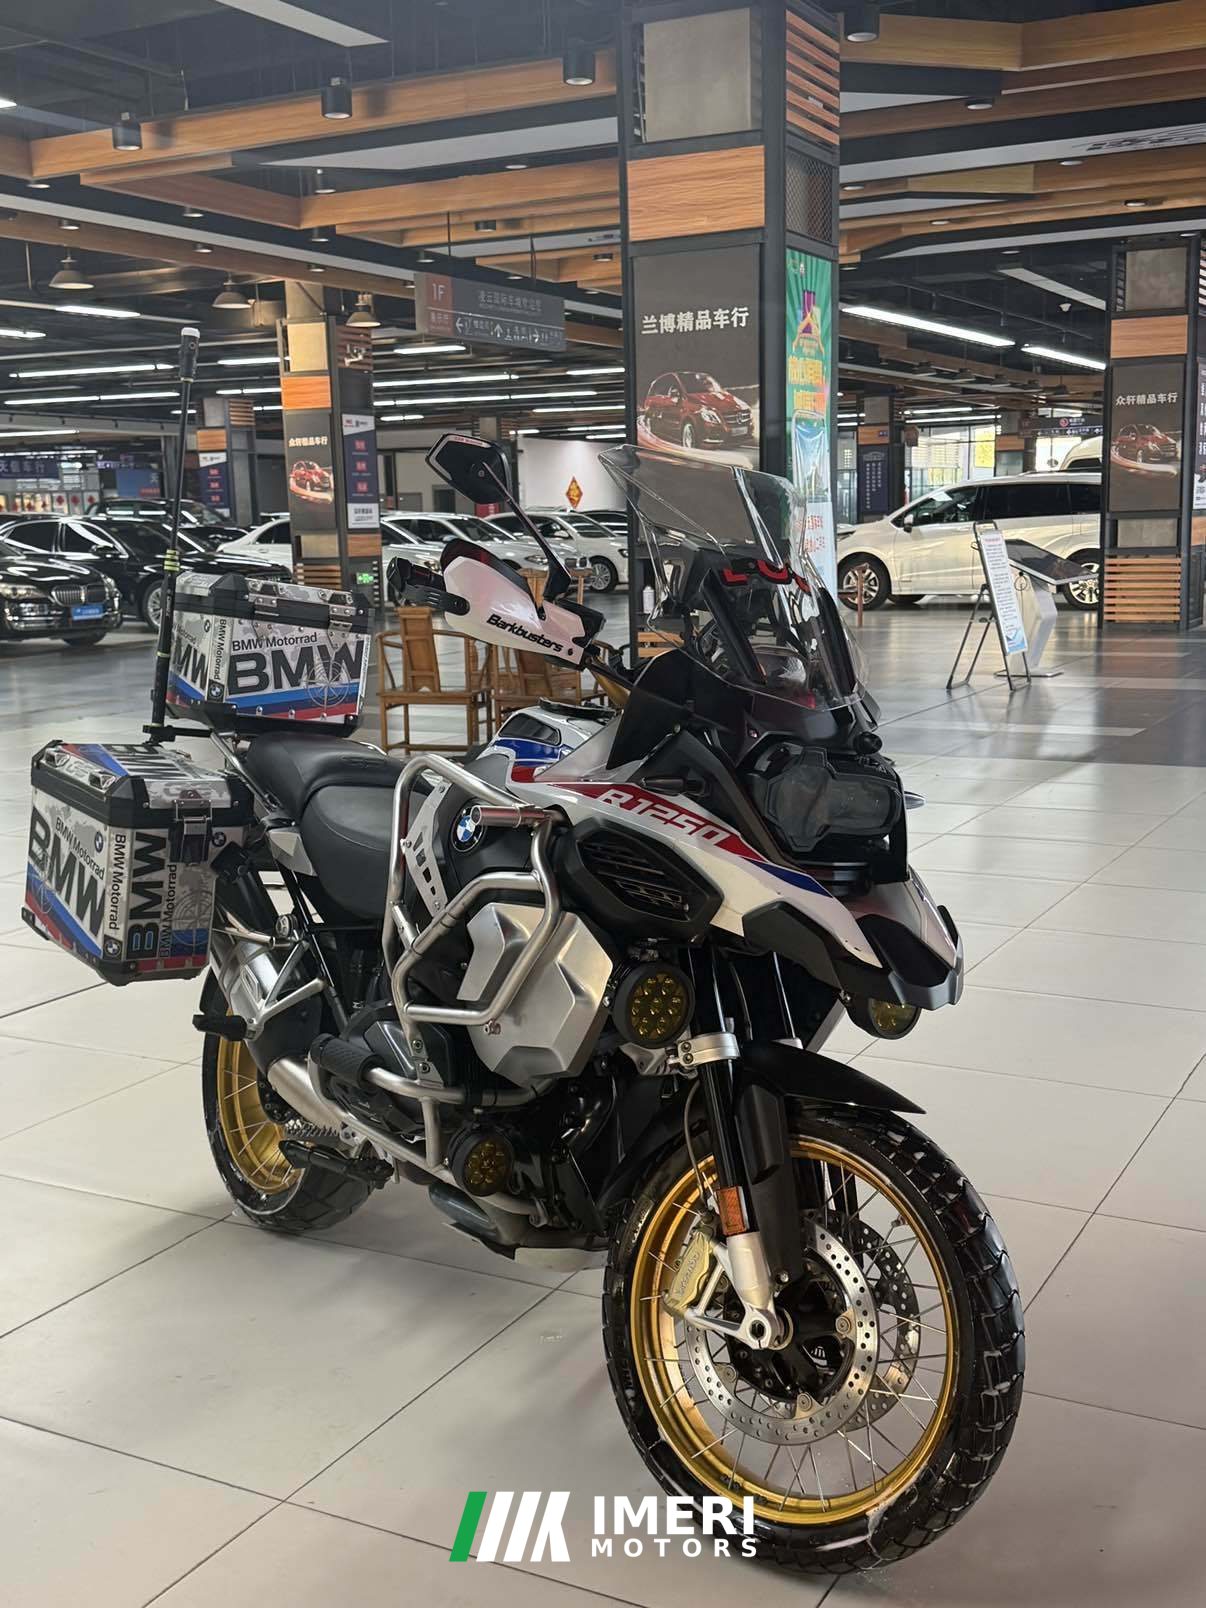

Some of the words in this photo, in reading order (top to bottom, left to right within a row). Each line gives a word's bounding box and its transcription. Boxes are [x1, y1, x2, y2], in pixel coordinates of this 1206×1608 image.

[431, 283, 446, 301] 1F
[641, 306, 750, 336] 兰博精品车行
[1115, 391, 1178, 406] 众轩精品车行
[218, 618, 227, 643] BMW
[232, 637, 263, 652] BMW
[265, 631, 318, 648] Motorrad
[486, 613, 563, 653] Barkbusters
[173, 638, 208, 689] MW
[213, 643, 225, 680] Motorrad
[228, 639, 365, 696] BMW
[596, 788, 732, 846] R1250
[54, 817, 73, 848] BMW
[72, 840, 105, 881] Motorrad
[114, 832, 127, 871] BMW
[29, 804, 106, 938] BMW
[108, 871, 125, 931] Motorrad
[128, 831, 167, 959] BMW
[164, 863, 177, 920] Motorrad
[159, 920, 171, 958] BMW
